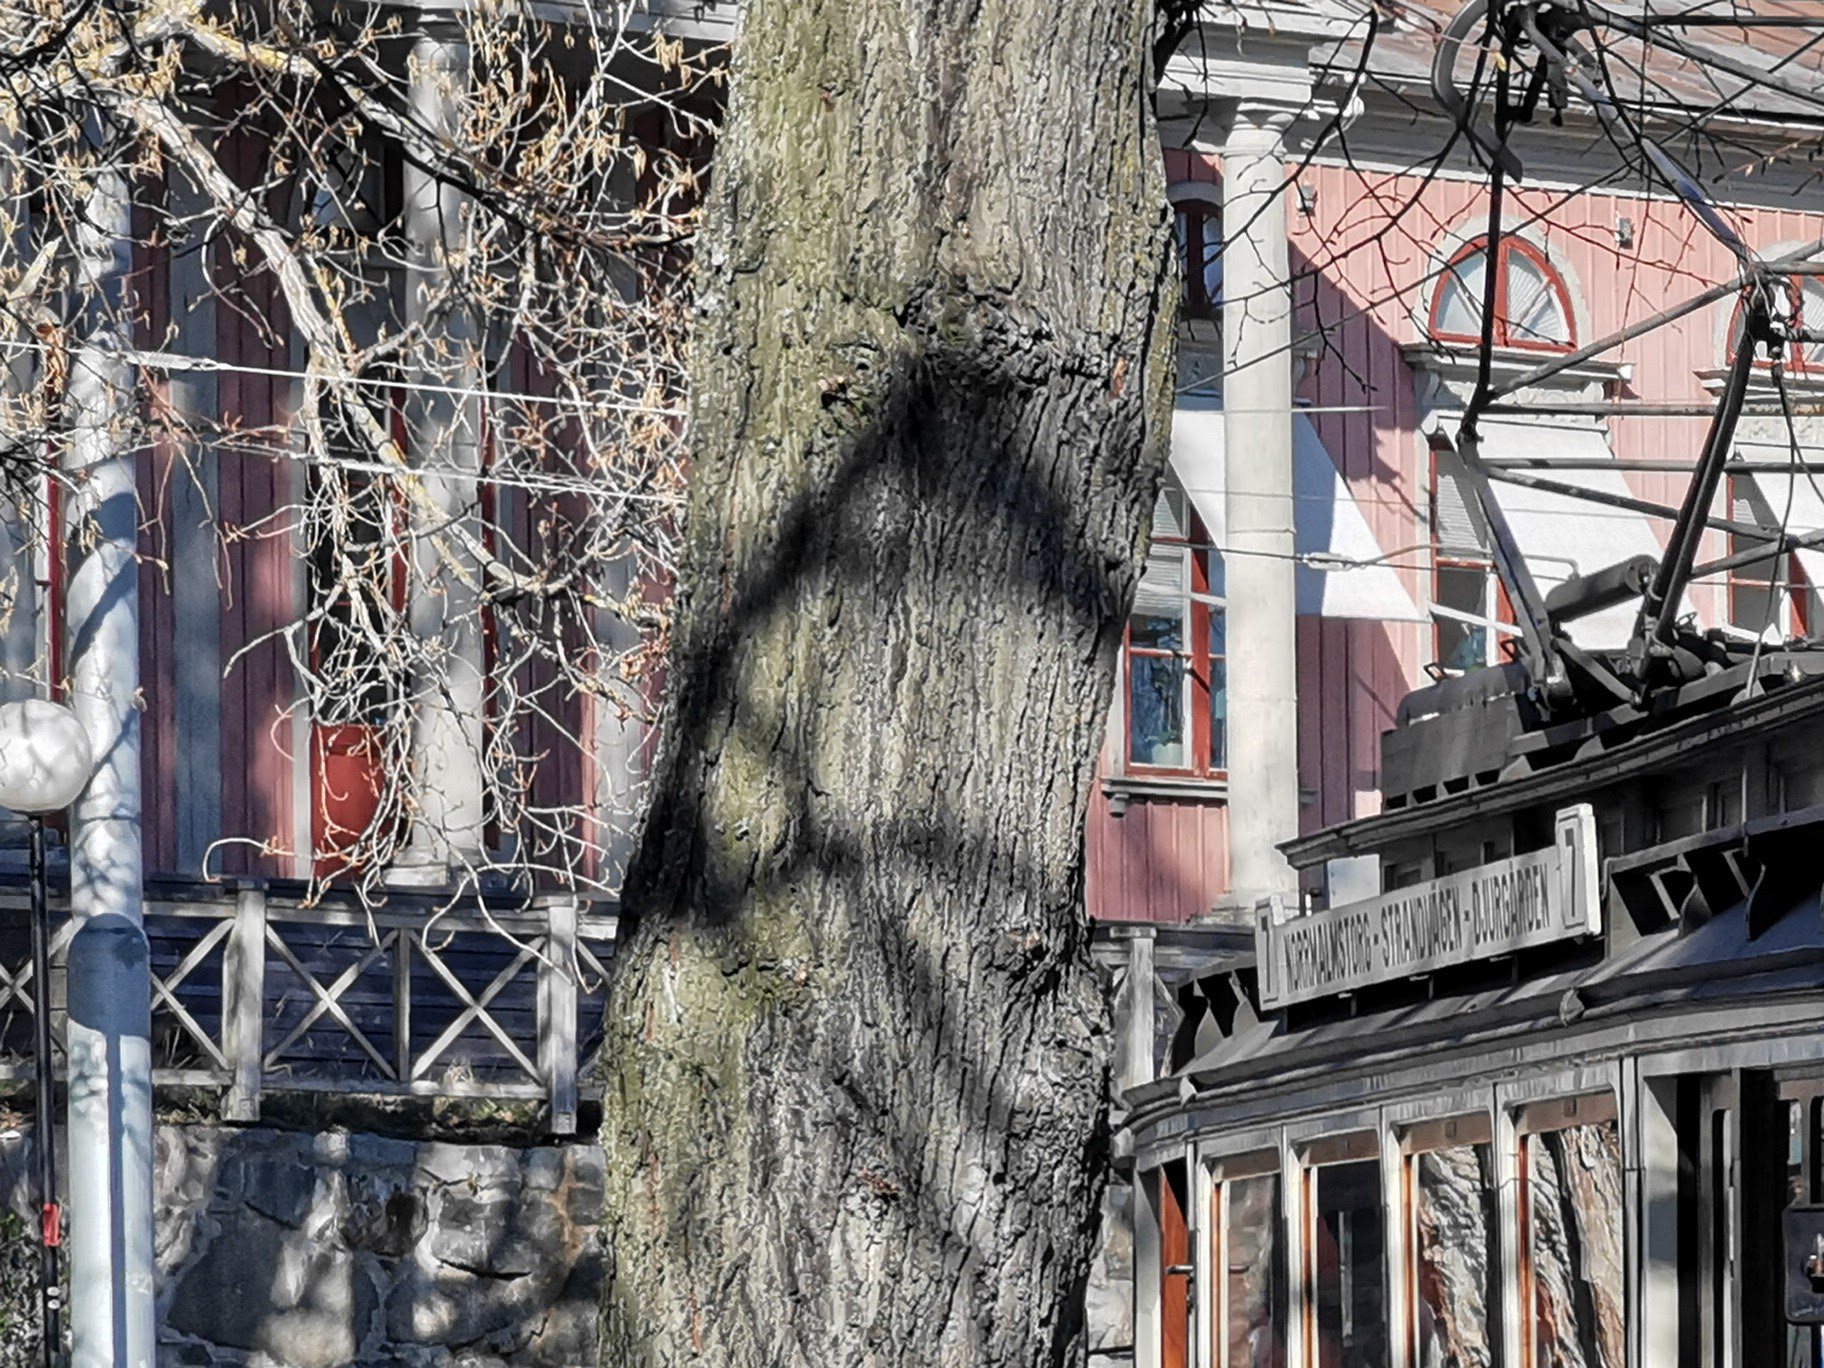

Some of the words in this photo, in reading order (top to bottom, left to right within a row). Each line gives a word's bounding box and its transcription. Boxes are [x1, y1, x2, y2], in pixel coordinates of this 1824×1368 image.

[1284, 912, 1372, 995] NORRMALMSTORG
[1381, 882, 1463, 968] STRANDVÄGEN
[1472, 860, 1551, 946] DJURGÅRDEN
